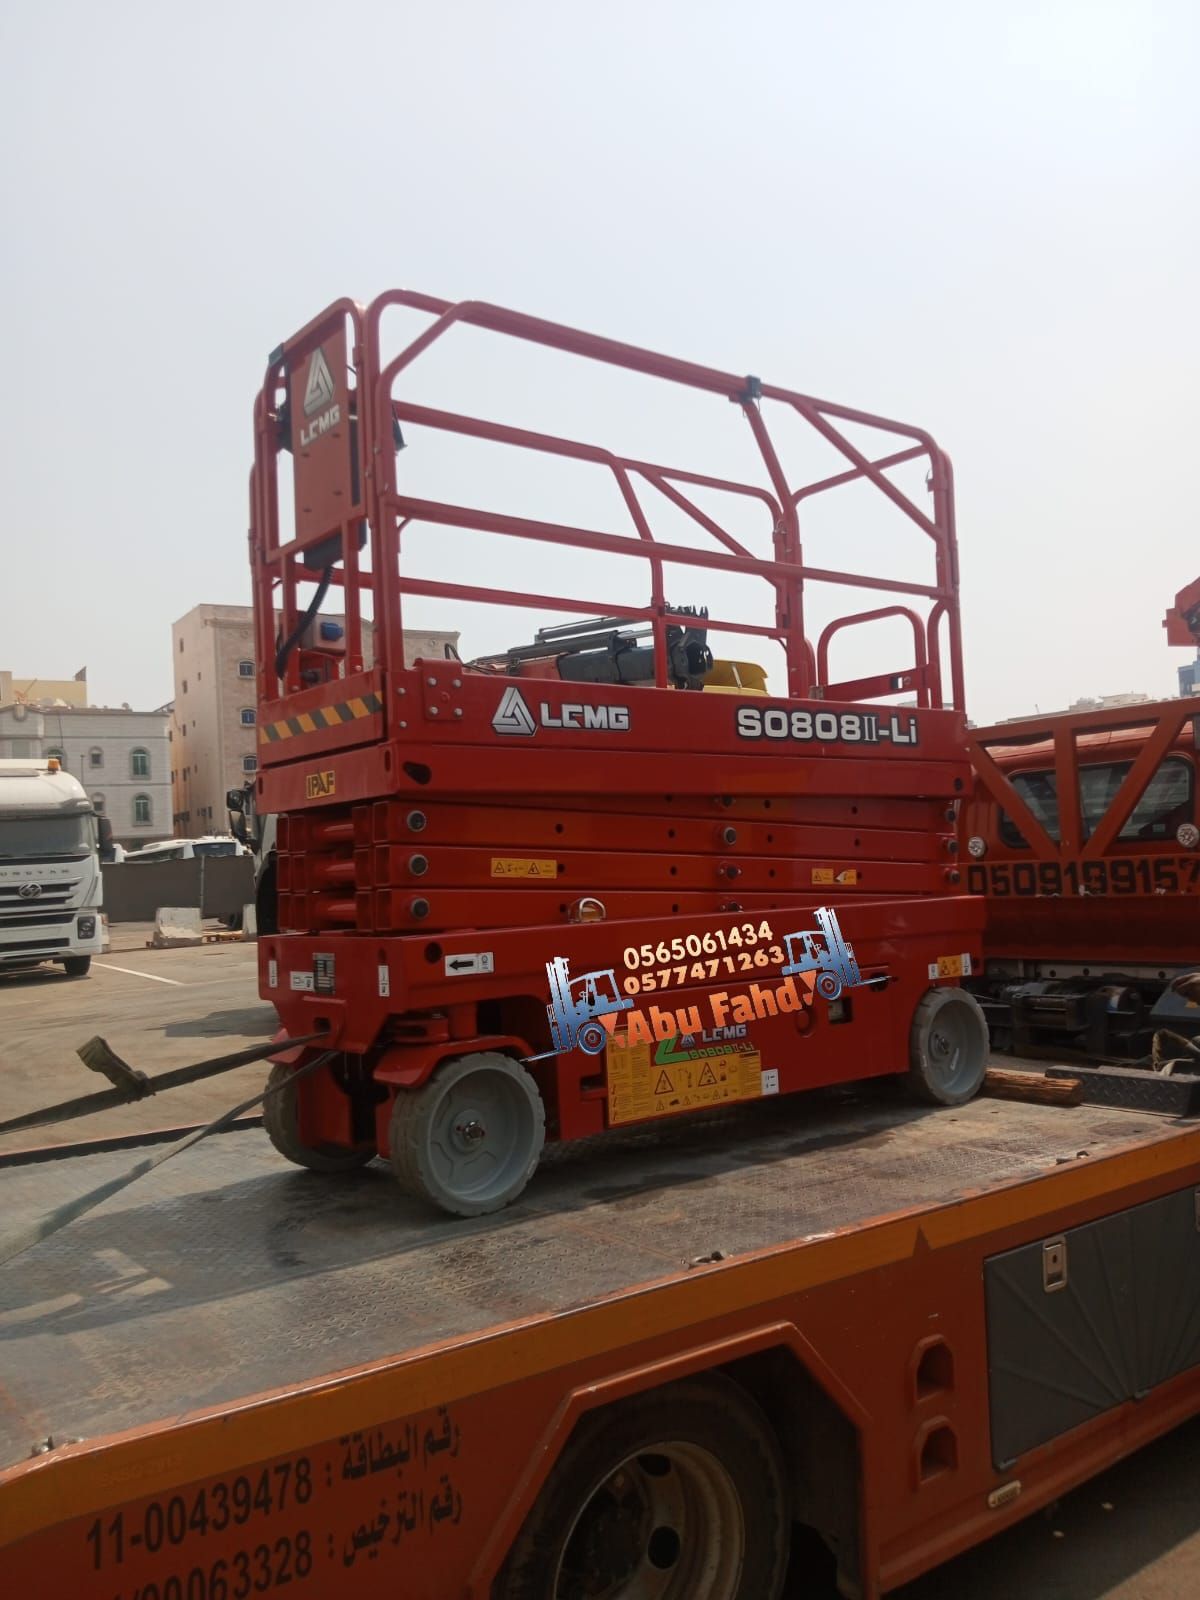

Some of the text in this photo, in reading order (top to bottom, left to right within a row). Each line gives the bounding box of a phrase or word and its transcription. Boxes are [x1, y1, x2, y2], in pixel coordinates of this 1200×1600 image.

[340, 1423, 419, 1480] البطاقة
[424, 1406, 461, 1471] رقم
[87, 1457, 312, 1570] 11-00439478
[343, 1488, 425, 1568] الترخيص
[429, 1474, 462, 1535] رقم
